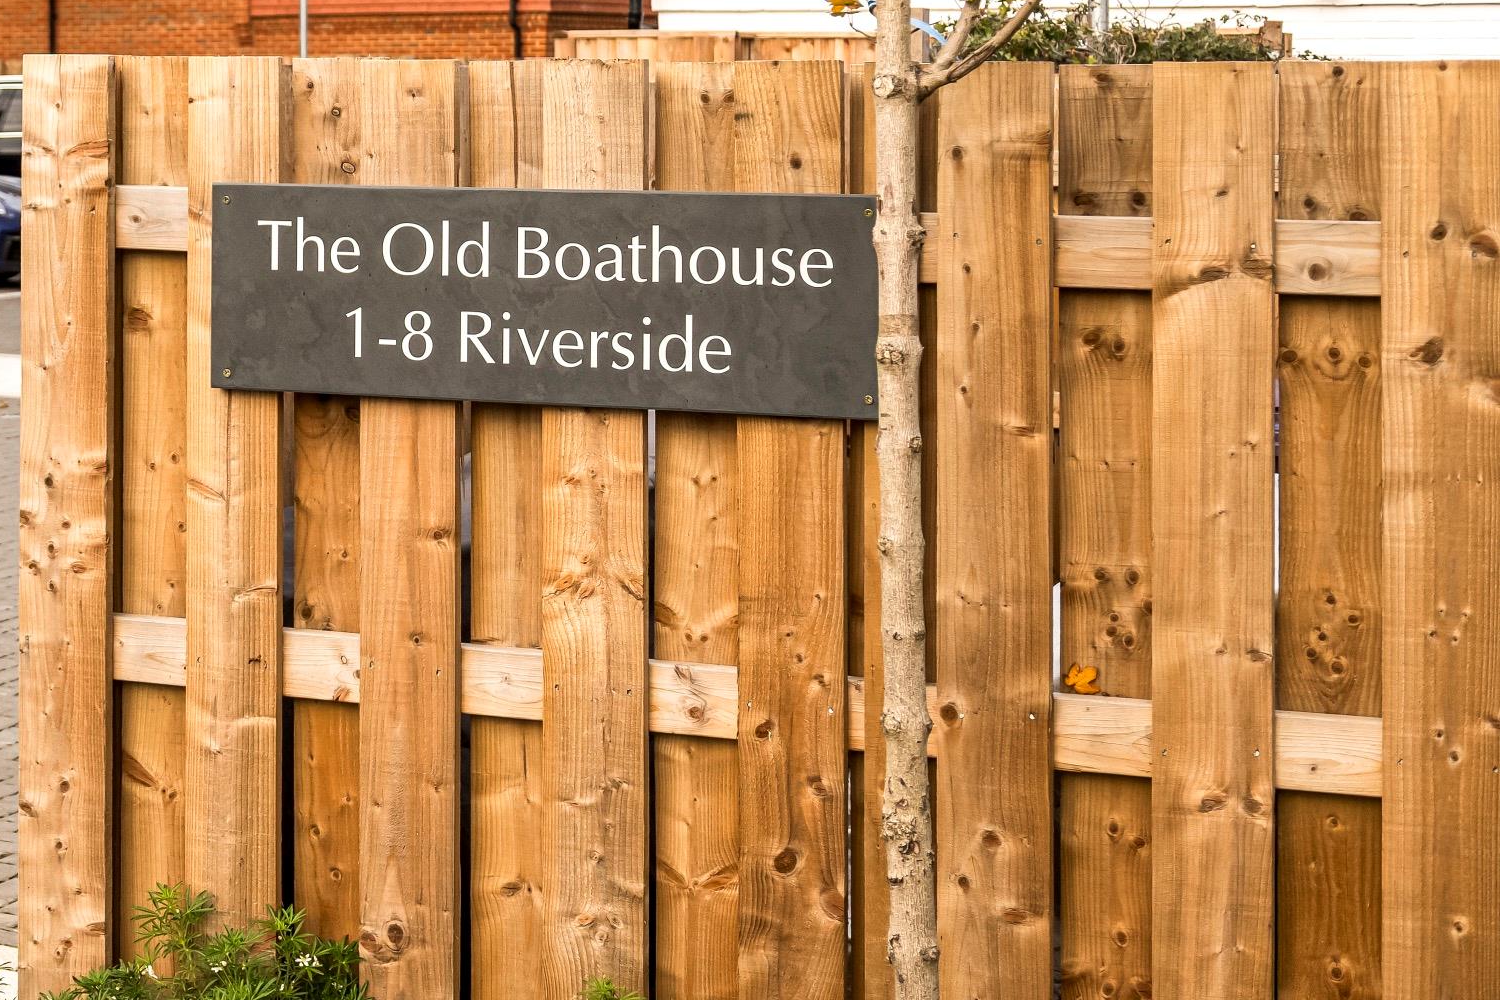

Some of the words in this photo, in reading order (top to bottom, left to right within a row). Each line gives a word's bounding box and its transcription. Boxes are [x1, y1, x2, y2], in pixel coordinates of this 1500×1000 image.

[257, 216, 361, 274] The
[382, 219, 490, 278] Old
[517, 224, 834, 288] Boathouse
[345, 306, 434, 362] 1-8
[459, 310, 732, 374] Riverside
